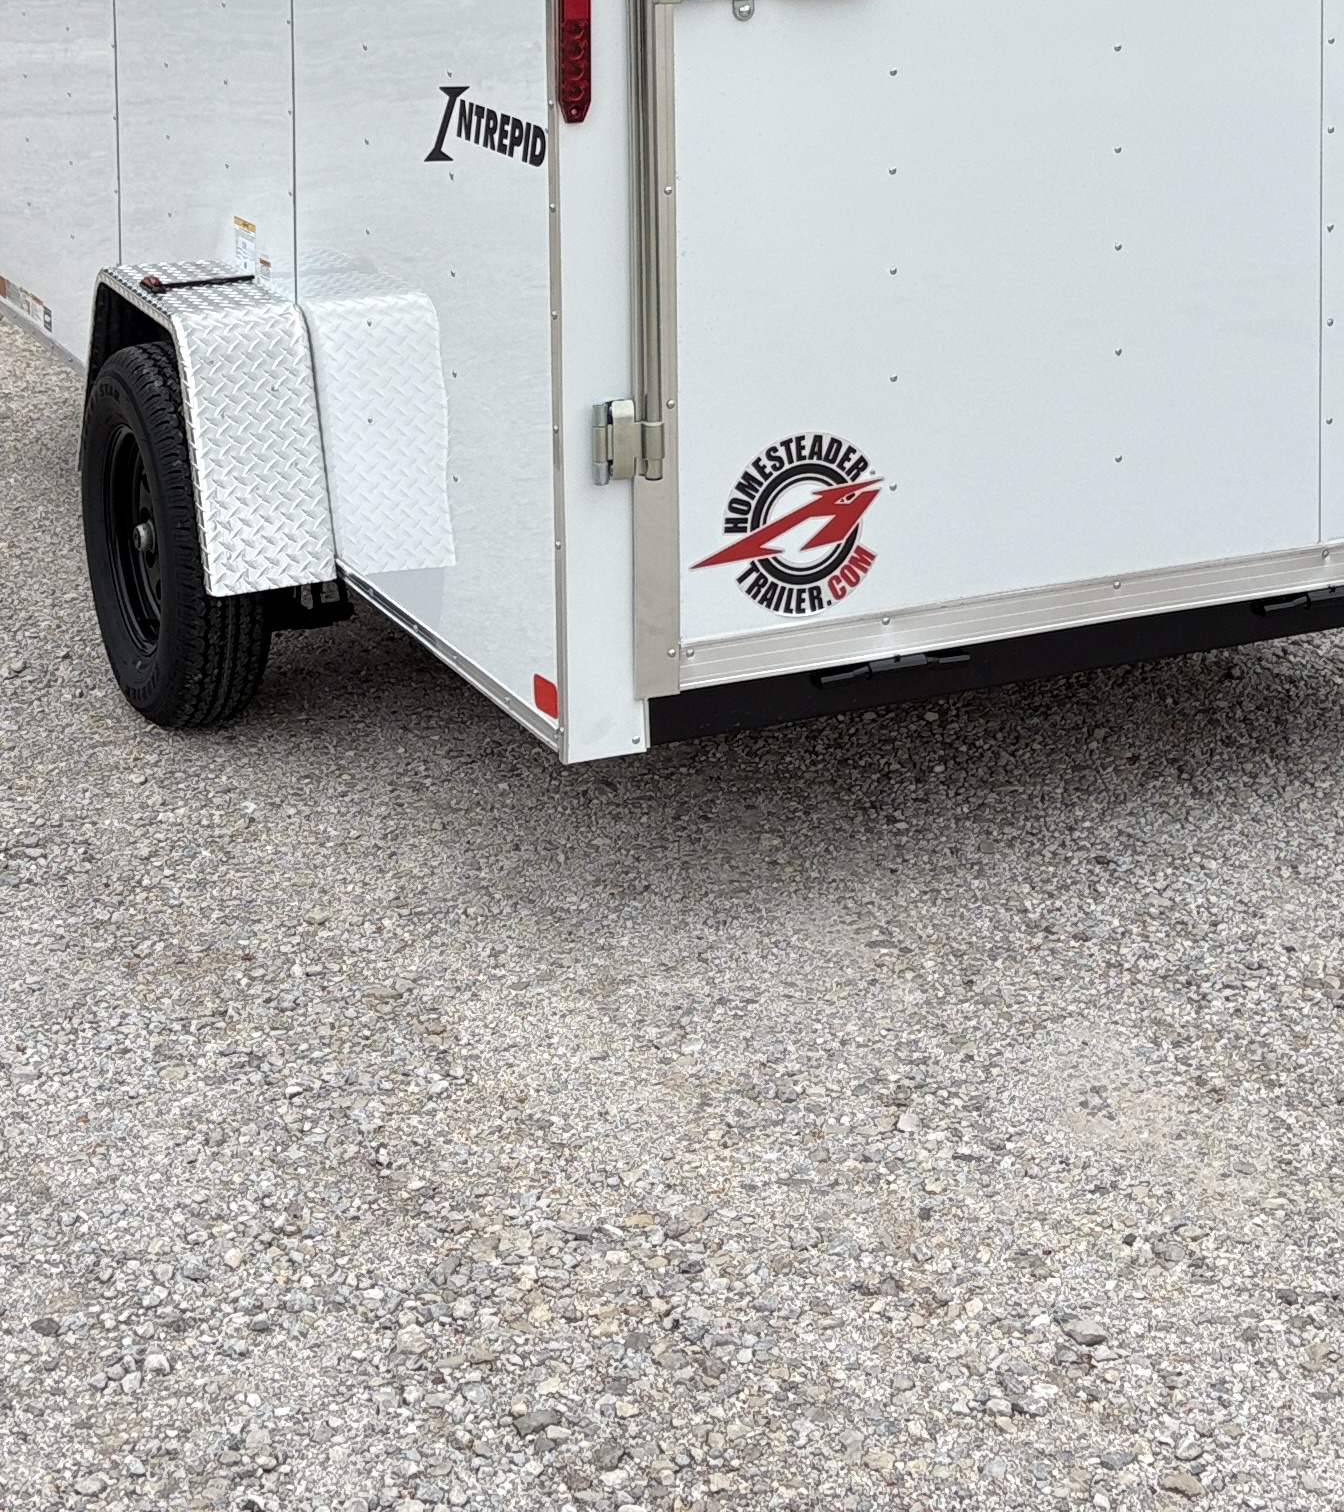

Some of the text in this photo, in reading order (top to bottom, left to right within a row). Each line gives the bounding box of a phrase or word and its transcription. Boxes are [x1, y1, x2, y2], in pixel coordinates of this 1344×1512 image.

[423, 85, 546, 168] INTREPID
[723, 434, 869, 535] HOMESTEADER
[736, 544, 877, 615] TRAILER.COM
